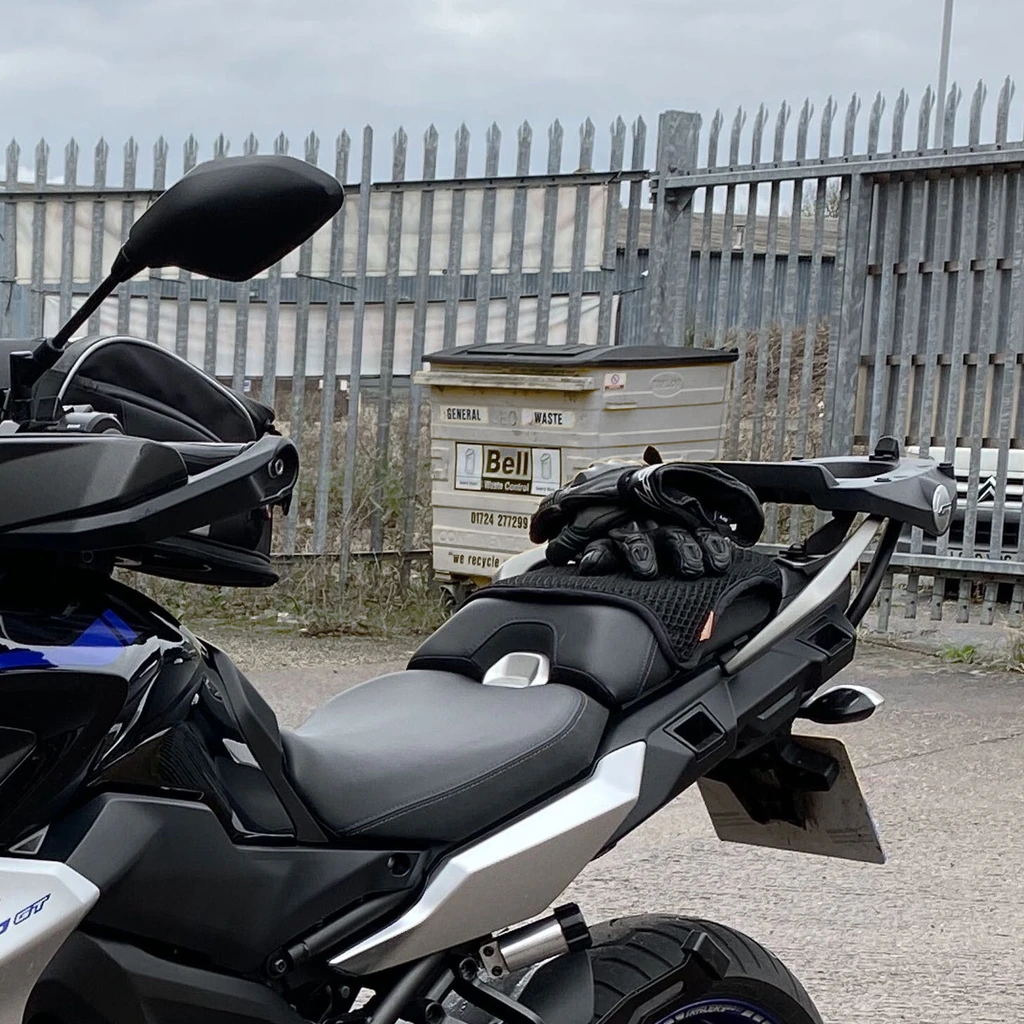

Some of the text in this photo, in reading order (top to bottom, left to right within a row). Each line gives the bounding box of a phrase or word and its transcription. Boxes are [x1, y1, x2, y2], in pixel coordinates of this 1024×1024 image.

[446, 407, 481, 421] GENERAL
[534, 411, 563, 426] WASTE
[485, 448, 529, 476] Bell
[484, 480, 504, 491] Waste
[504, 481, 530, 493] Control
[471, 511, 529, 530] 01724 277299
[467, 554, 500, 569] recycle
